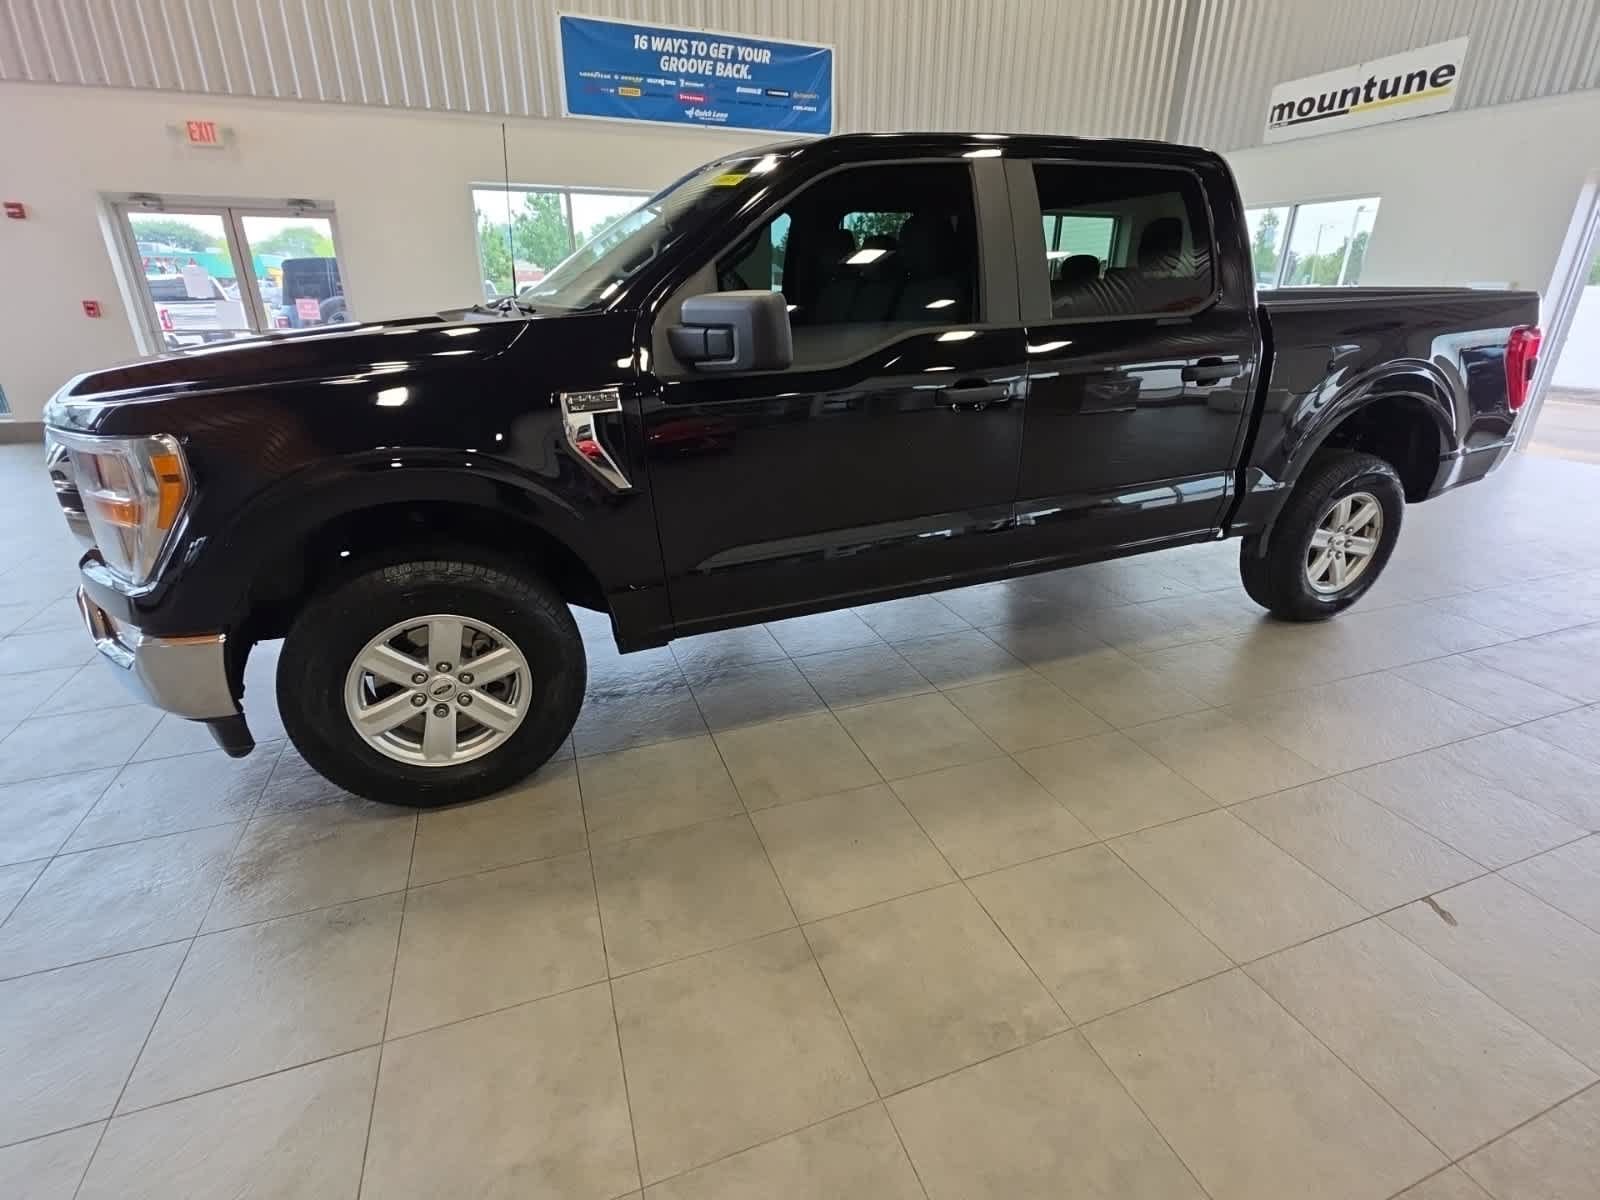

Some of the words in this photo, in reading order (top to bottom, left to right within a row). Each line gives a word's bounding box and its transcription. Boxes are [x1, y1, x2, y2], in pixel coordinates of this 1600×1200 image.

[634, 34, 648, 50] 16
[651, 36, 688, 55] WAYS
[691, 40, 707, 56] TO
[709, 42, 735, 59] GET
[737, 46, 771, 64] YOUR
[660, 55, 713, 75] GROOVE
[715, 61, 752, 80] BACK.
[1269, 63, 1456, 123] mountune
[186, 120, 217, 143] EXIT
